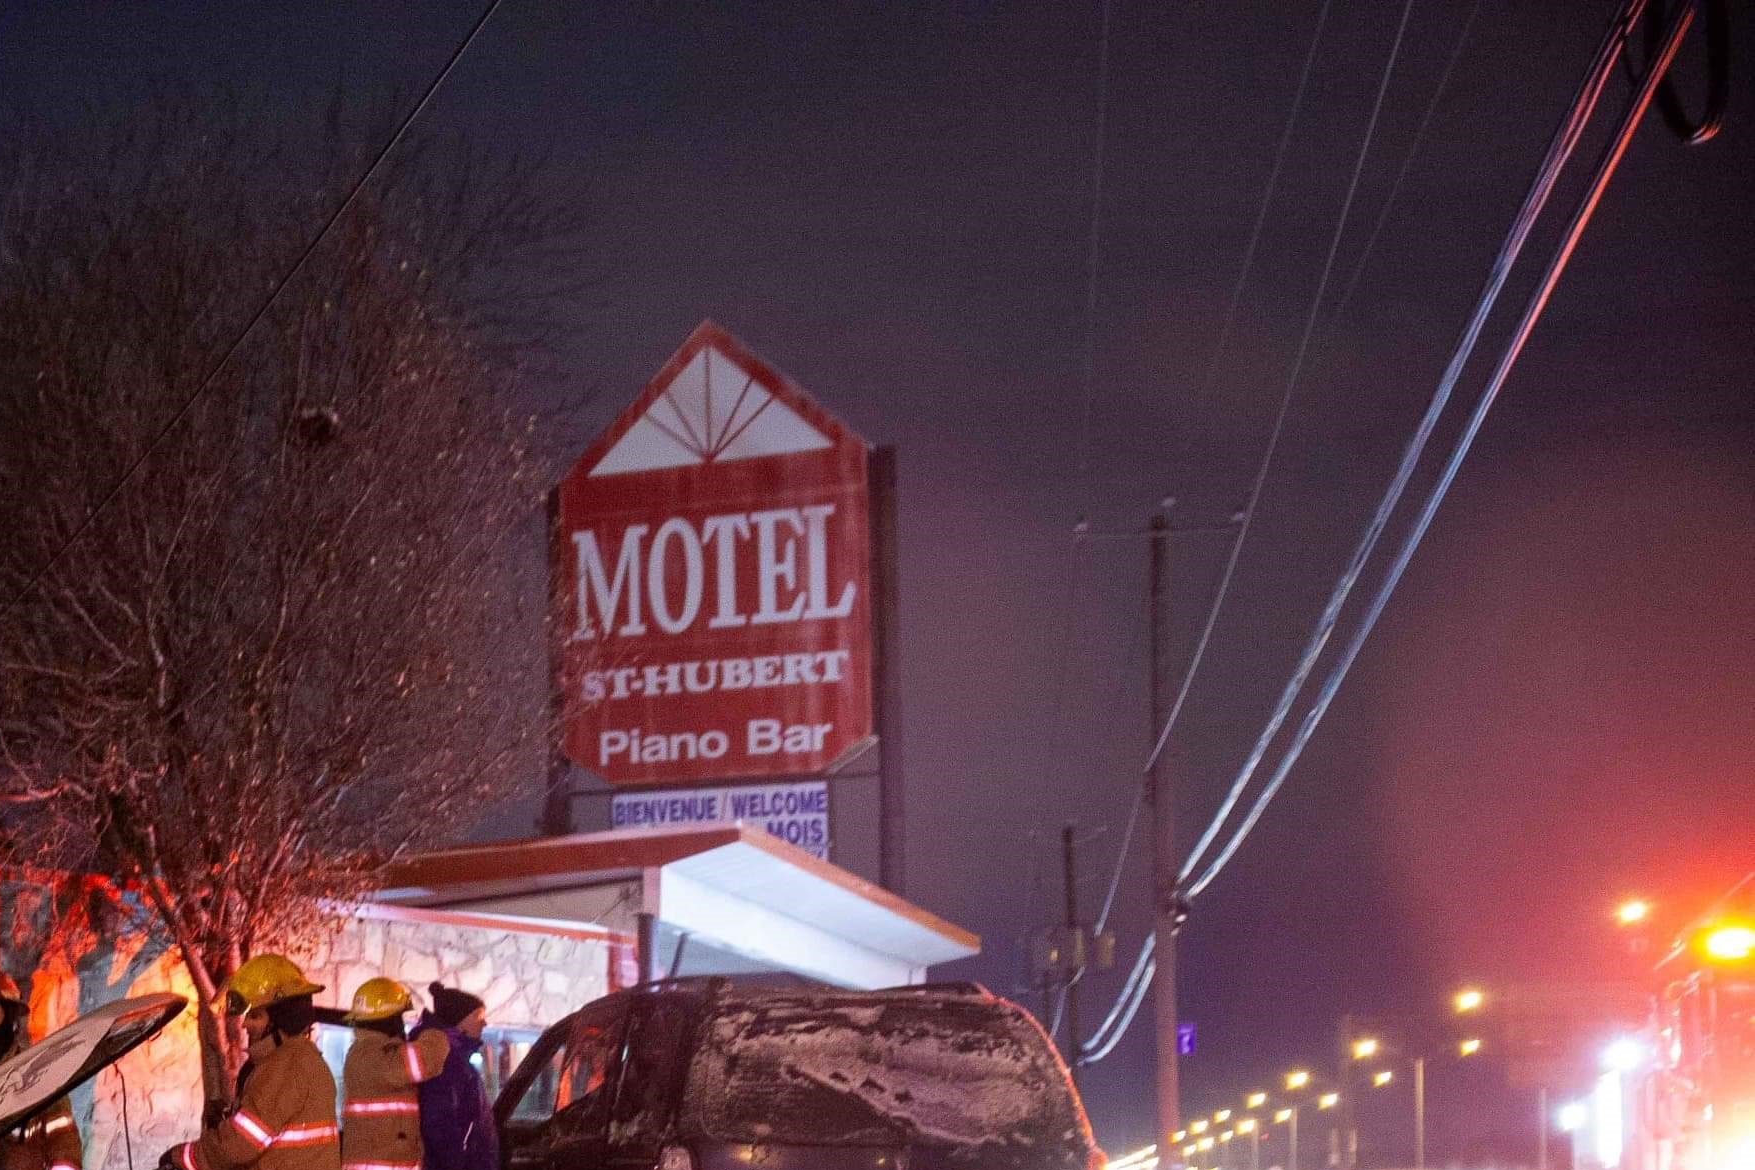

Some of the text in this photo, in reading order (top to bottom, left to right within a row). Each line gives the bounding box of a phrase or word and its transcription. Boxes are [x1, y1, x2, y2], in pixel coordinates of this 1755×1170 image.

[571, 504, 856, 642] MOTEL
[580, 651, 848, 700] ST-HUBERT
[599, 719, 833, 767] Piano Bar
[614, 797, 719, 827] BIENVENUE
[731, 789, 828, 818] WELCOME
